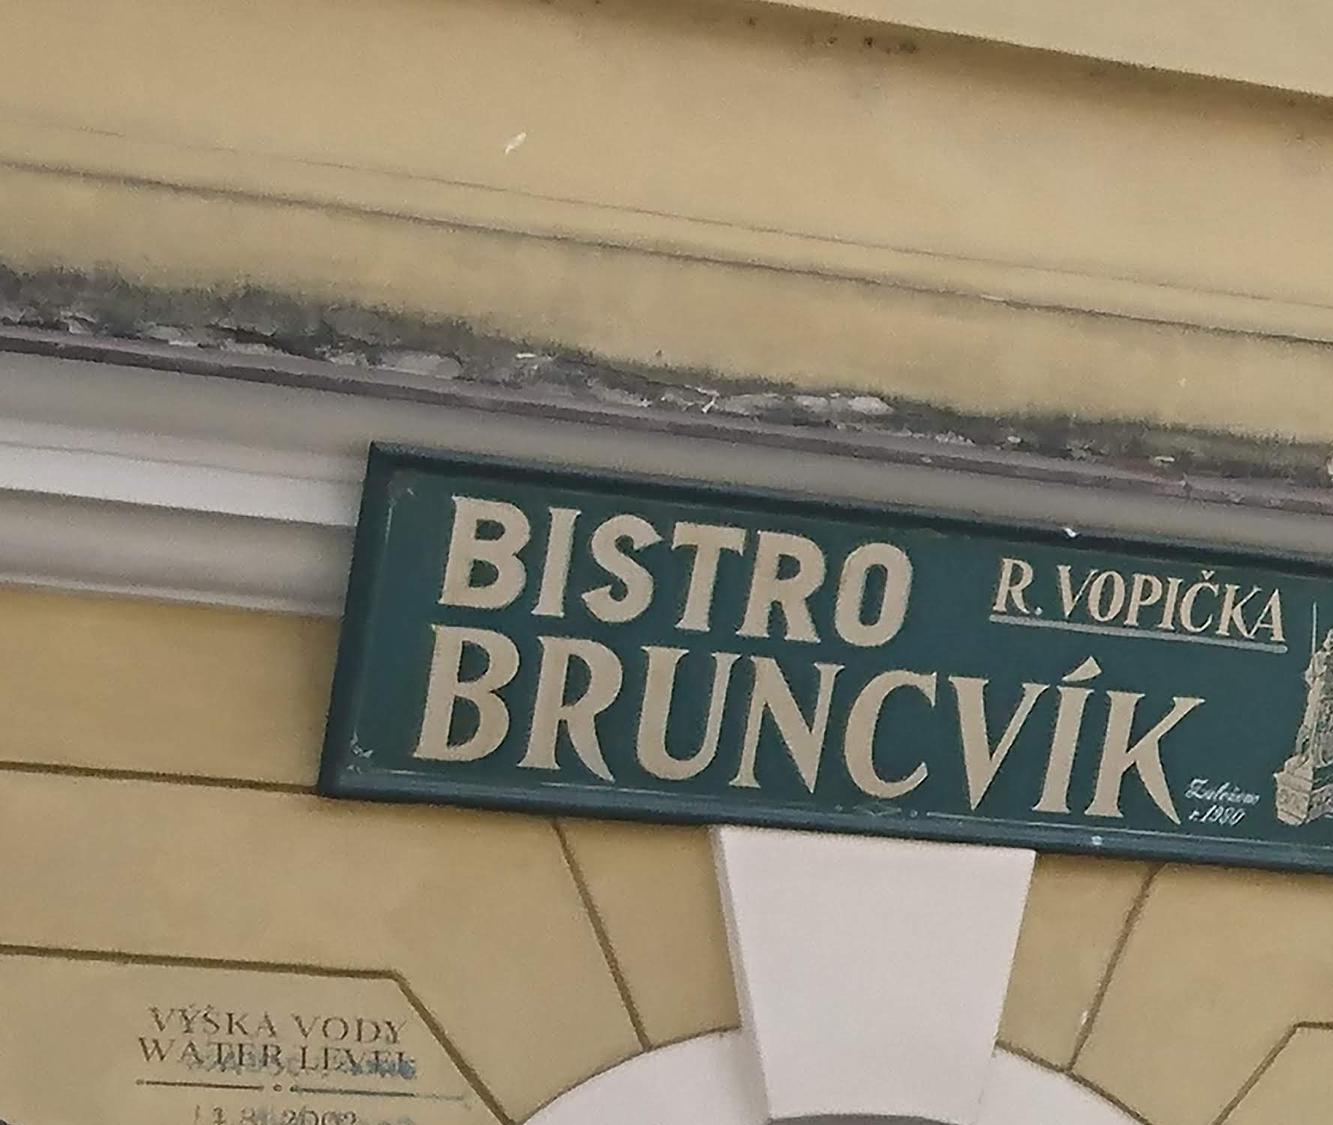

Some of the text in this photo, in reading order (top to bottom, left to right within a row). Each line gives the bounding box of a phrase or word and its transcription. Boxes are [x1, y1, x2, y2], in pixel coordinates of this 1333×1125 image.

[437, 495, 913, 648] BISTRO
[1056, 564, 1286, 643] VOPIČKA
[412, 623, 1206, 825] BRUNCVÍK
[138, 1036, 283, 1072] WATER
[148, 1004, 406, 1045] VÝŠKA VODY
